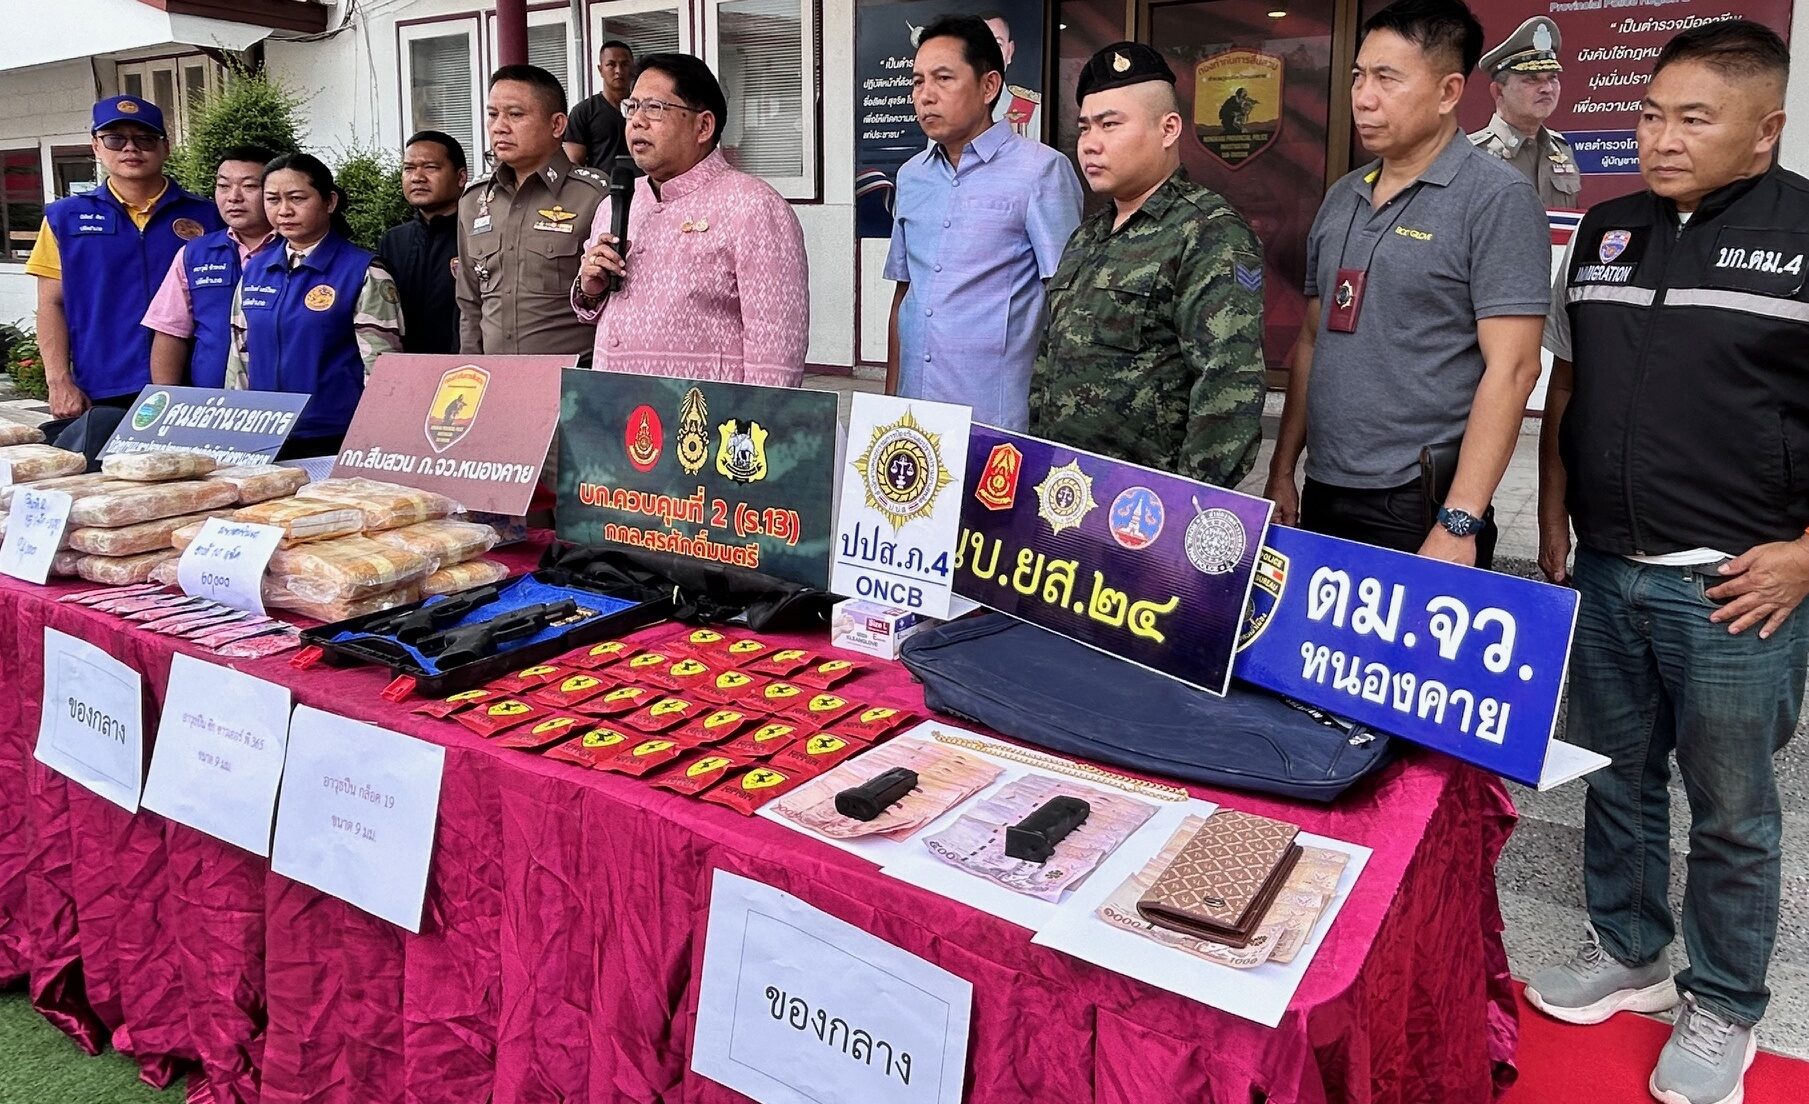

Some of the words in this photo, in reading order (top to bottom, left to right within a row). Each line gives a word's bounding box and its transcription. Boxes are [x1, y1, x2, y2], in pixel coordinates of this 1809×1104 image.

[1716, 247, 1804, 276] บก.ตม.4
[158, 397, 295, 437] ศูนย์อำนวยการ
[579, 482, 705, 527] บก.ควบคุมที่
[710, 498, 728, 529] 2
[733, 502, 801, 547] (ร.13)
[841, 521, 949, 578] ปปส.ภ.4
[855, 575, 924, 609] ONCB
[1306, 565, 1535, 682] ตม.จว.
[1299, 640, 1512, 746] หนองคาย
[68, 696, 127, 745] ของกลาง
[214, 756, 221, 767] 9
[251, 736, 265, 751] 365
[384, 795, 396, 809] 19
[331, 813, 353, 833] ขนาด
[354, 824, 362, 836] 9
[765, 985, 913, 1085] ของกลาง
